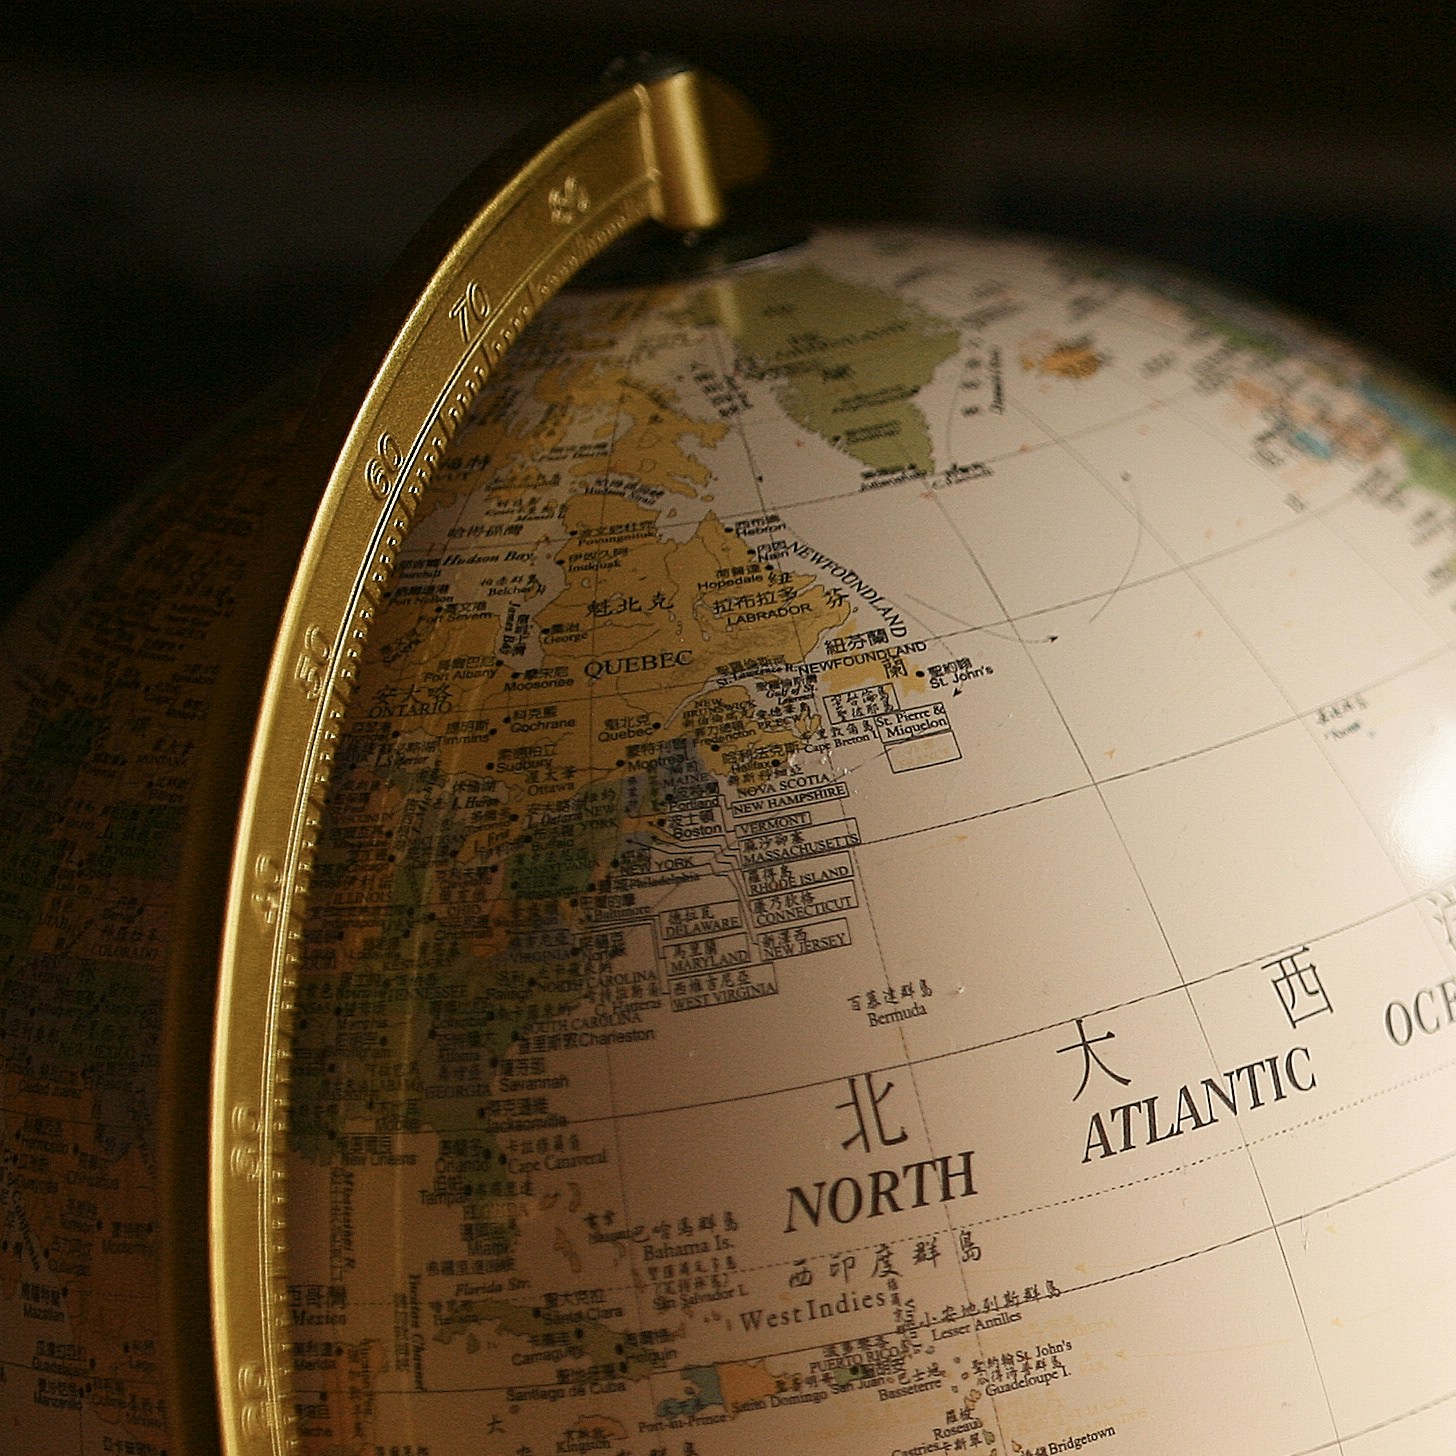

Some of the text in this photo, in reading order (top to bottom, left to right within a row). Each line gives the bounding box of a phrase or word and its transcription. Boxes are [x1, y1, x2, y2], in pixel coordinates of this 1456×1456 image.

[450, 280, 493, 342] 70
[364, 431, 406, 501] 60
[443, 550, 535, 568] Hudson Bay
[758, 551, 789, 563] Nain
[698, 574, 764, 591] Hopedale
[788, 541, 908, 639] NEWFOUNDLAND
[727, 603, 812, 626] LABRADOR
[583, 649, 694, 680] QUEBEC
[798, 641, 927, 675] NEWFOUNDLAND
[503, 677, 575, 693] Moosonee
[953, 664, 995, 685] John's
[368, 700, 453, 720] ONTARIO
[898, 709, 931, 724] Pierre
[933, 703, 946, 716] &
[510, 716, 576, 733] Cochrane
[598, 726, 653, 743] Quebec
[886, 717, 948, 739] Miquelon
[805, 732, 867, 753] Cape Breton
[737, 773, 832, 799] NOVA SCOTIA
[733, 785, 847, 815] NEW HAMPSHIRE
[673, 823, 723, 840] Boston
[740, 813, 808, 834] VERMONT
[743, 832, 860, 867] MASSACHUSETTS
[655, 856, 695, 872] YORK
[751, 865, 849, 896] RHODE ISLAND
[756, 895, 852, 926] CONNECTICUT
[665, 916, 740, 937] DELAWARE
[763, 932, 846, 960] NEW JERSEY
[670, 950, 750, 974] MARYLAND
[587, 970, 657, 990] CAROLINA
[714, 981, 778, 1003] VIRGINIA
[867, 1003, 928, 1029] Bermuda
[836, 1072, 909, 1154] 北
[1056, 1016, 1132, 1101] 大
[1261, 945, 1336, 1031] 西
[782, 1148, 978, 1233] NORTH
[1082, 1045, 1318, 1165] ATLANTIC
[644, 1239, 709, 1261] Bahama
[788, 1229, 984, 1289] 西印度群島
[740, 1287, 887, 1333] West Indies
[931, 1310, 1023, 1343] Lesser Antilles
[1035, 1338, 1073, 1358] John's
[808, 1354, 864, 1375] PUERTO
[878, 1378, 943, 1401] Basseterre
[985, 1368, 1061, 1398] Guadeloupe
[770, 1389, 829, 1408] Domingo
[1048, 1424, 1117, 1456] Bridgetown
